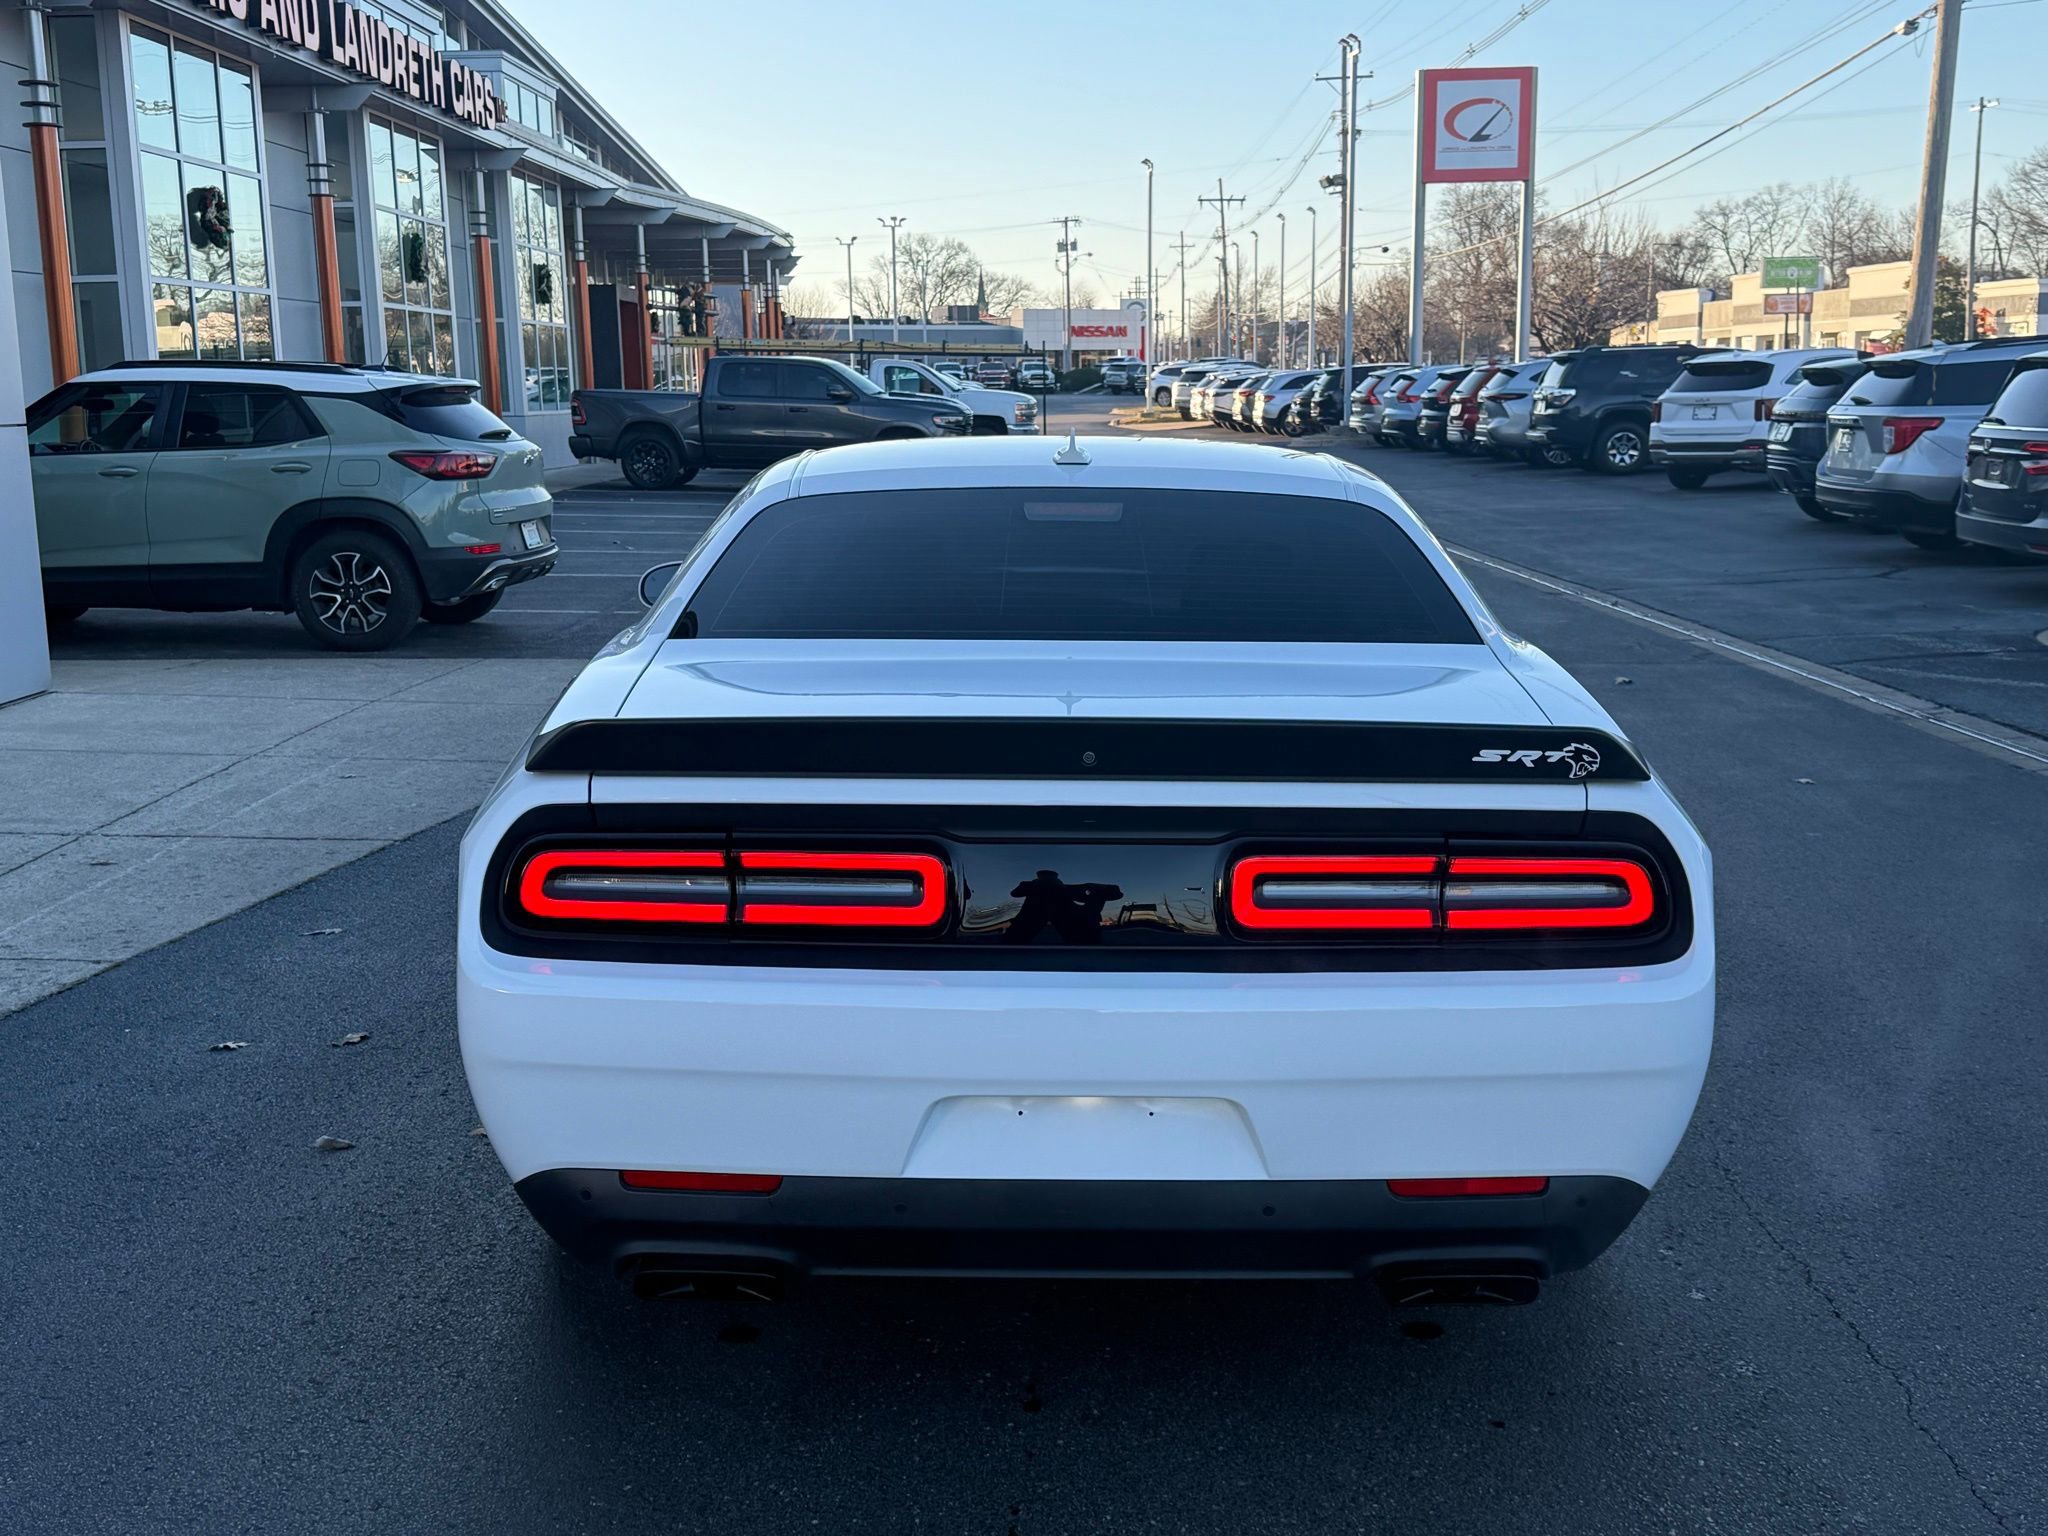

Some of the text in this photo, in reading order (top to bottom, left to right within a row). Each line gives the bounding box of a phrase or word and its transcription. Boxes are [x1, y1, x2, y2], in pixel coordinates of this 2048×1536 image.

[329, 0, 446, 109] LANDRETH
[450, 58, 496, 131] CARS
[1070, 325, 1128, 337] NISSAN
[1472, 749, 1574, 768] SRT
